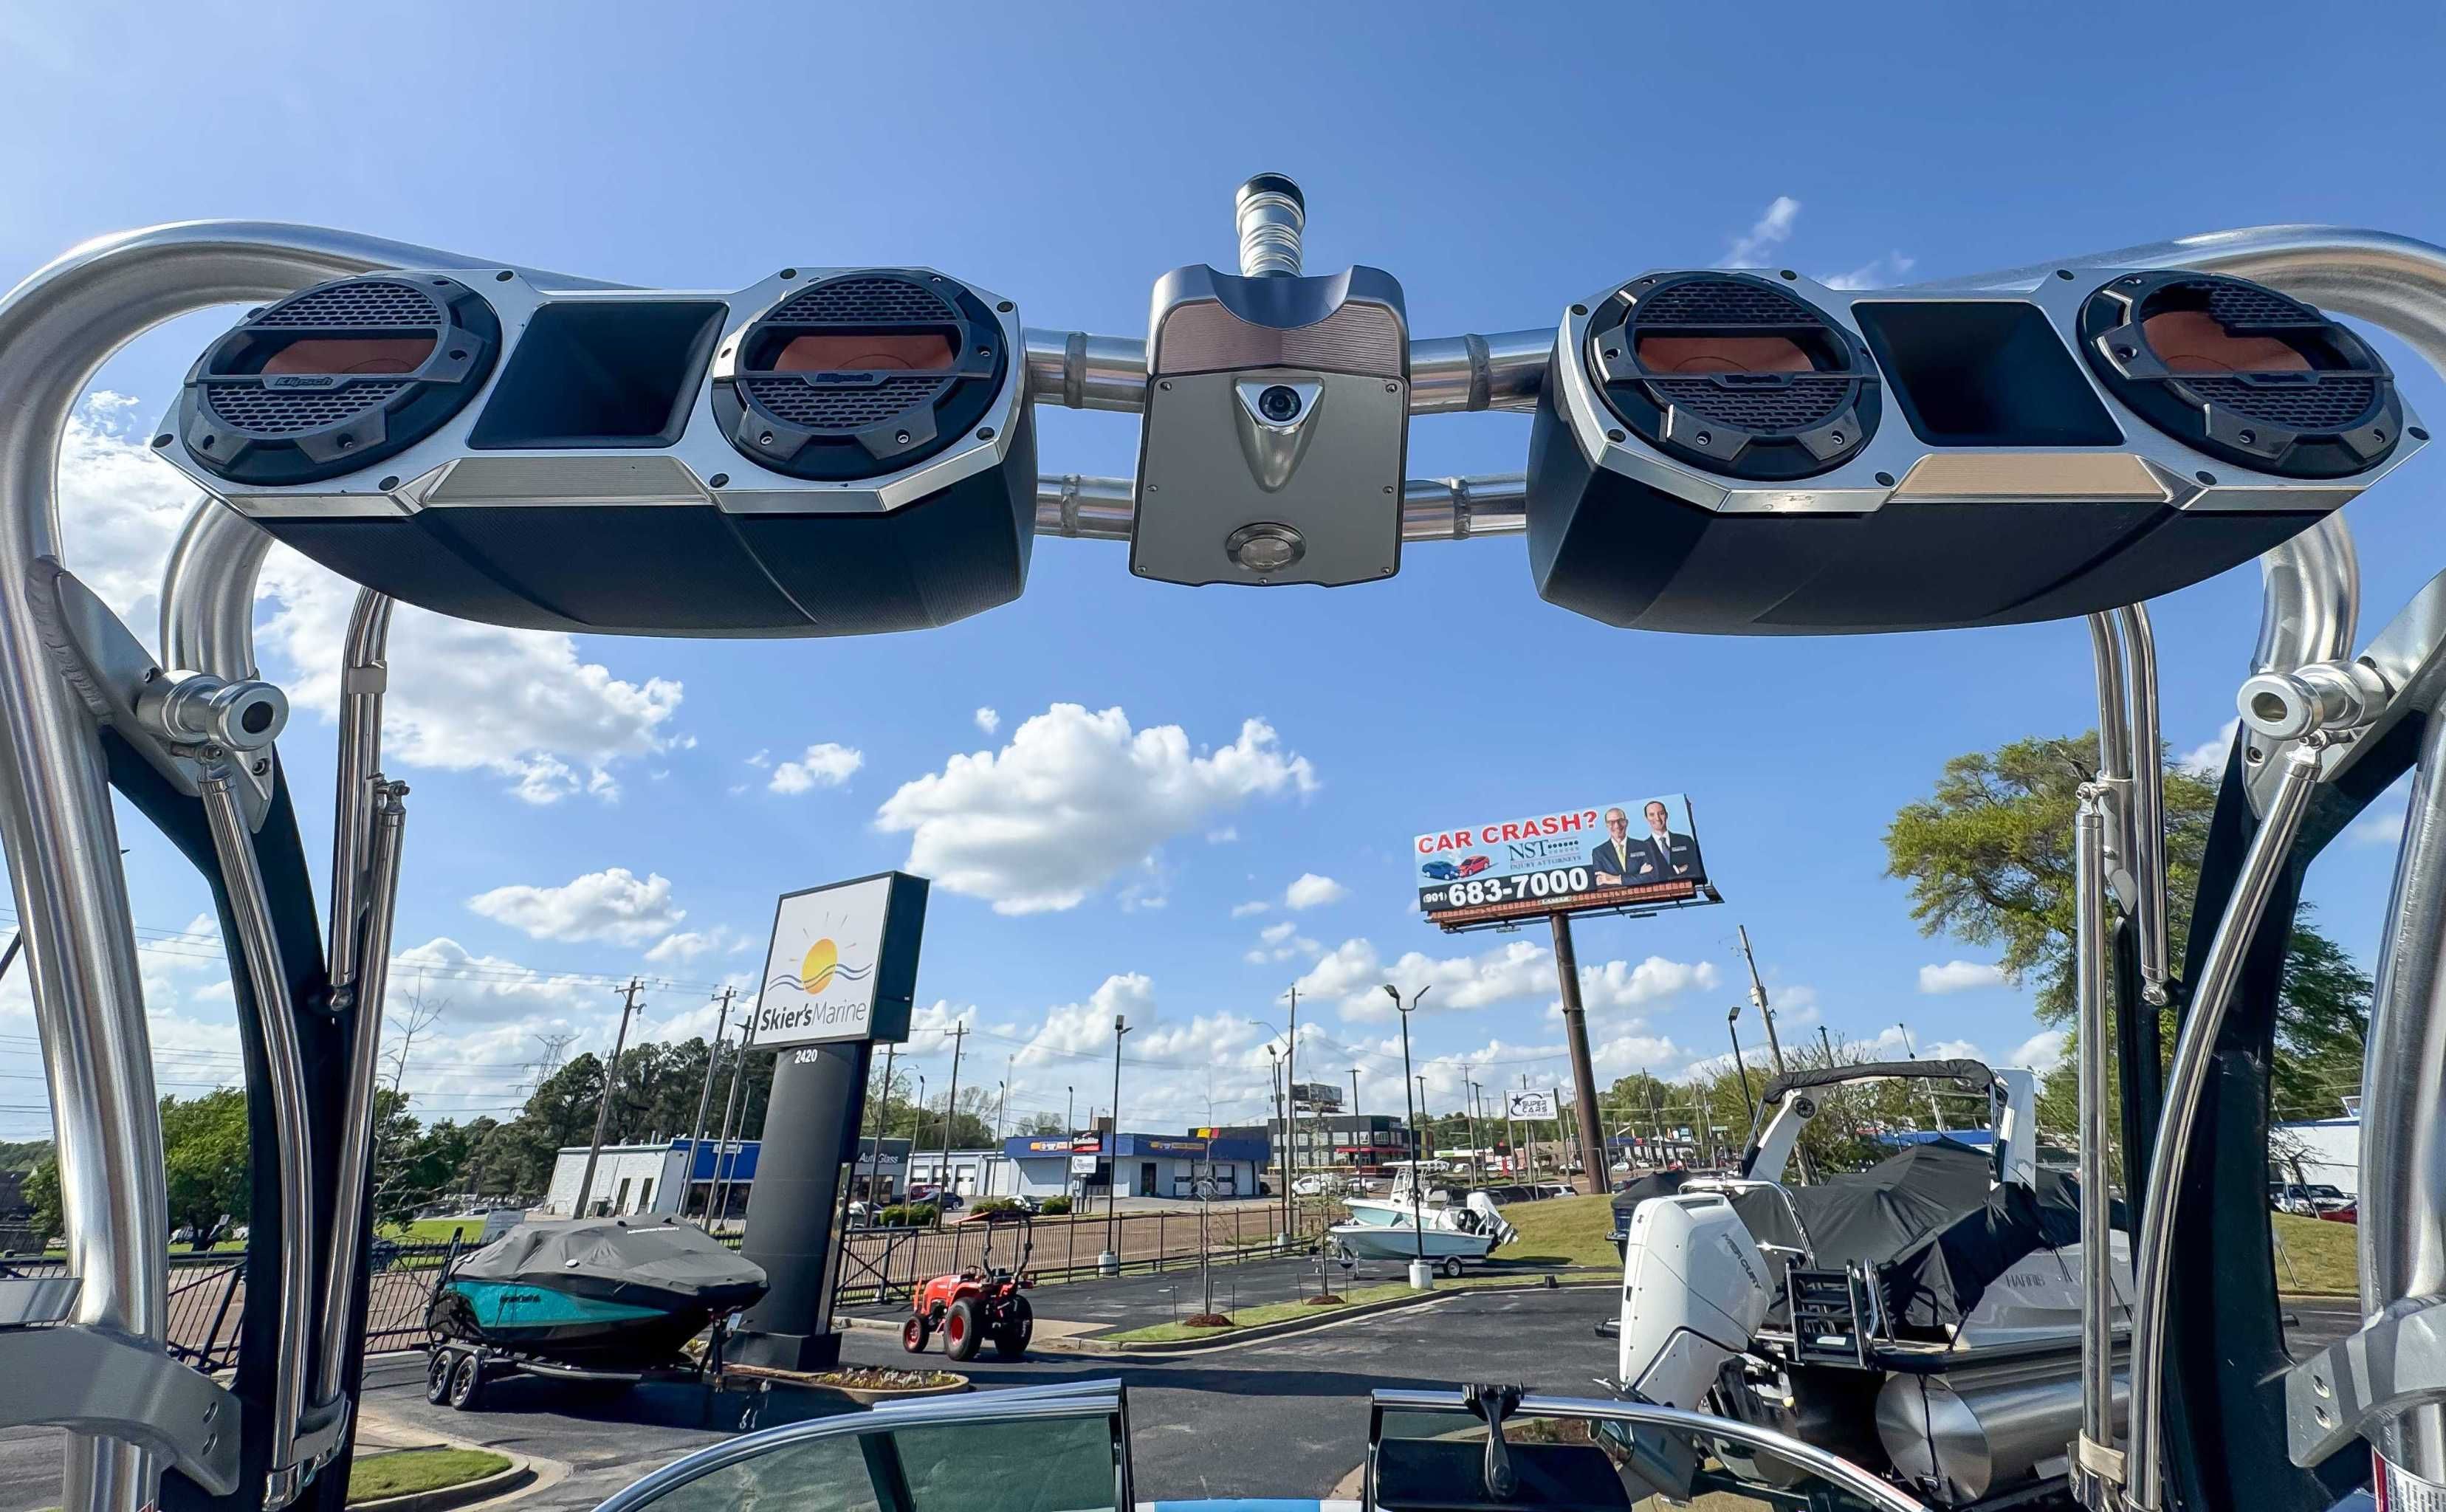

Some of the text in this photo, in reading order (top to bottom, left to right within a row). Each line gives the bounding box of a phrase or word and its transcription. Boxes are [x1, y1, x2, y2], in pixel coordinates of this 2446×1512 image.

[275, 377, 334, 387] Klipsch
[1418, 811, 1598, 853] CAR CRASH?
[1507, 839, 1549, 861] NST
[1536, 855, 1582, 867] ATTORNEYS
[1449, 867, 1589, 907] 683-7000
[794, 1048, 818, 1064] 2420
[879, 1152, 899, 1164] Glass
[1721, 1232, 1762, 1289] MERCURY
